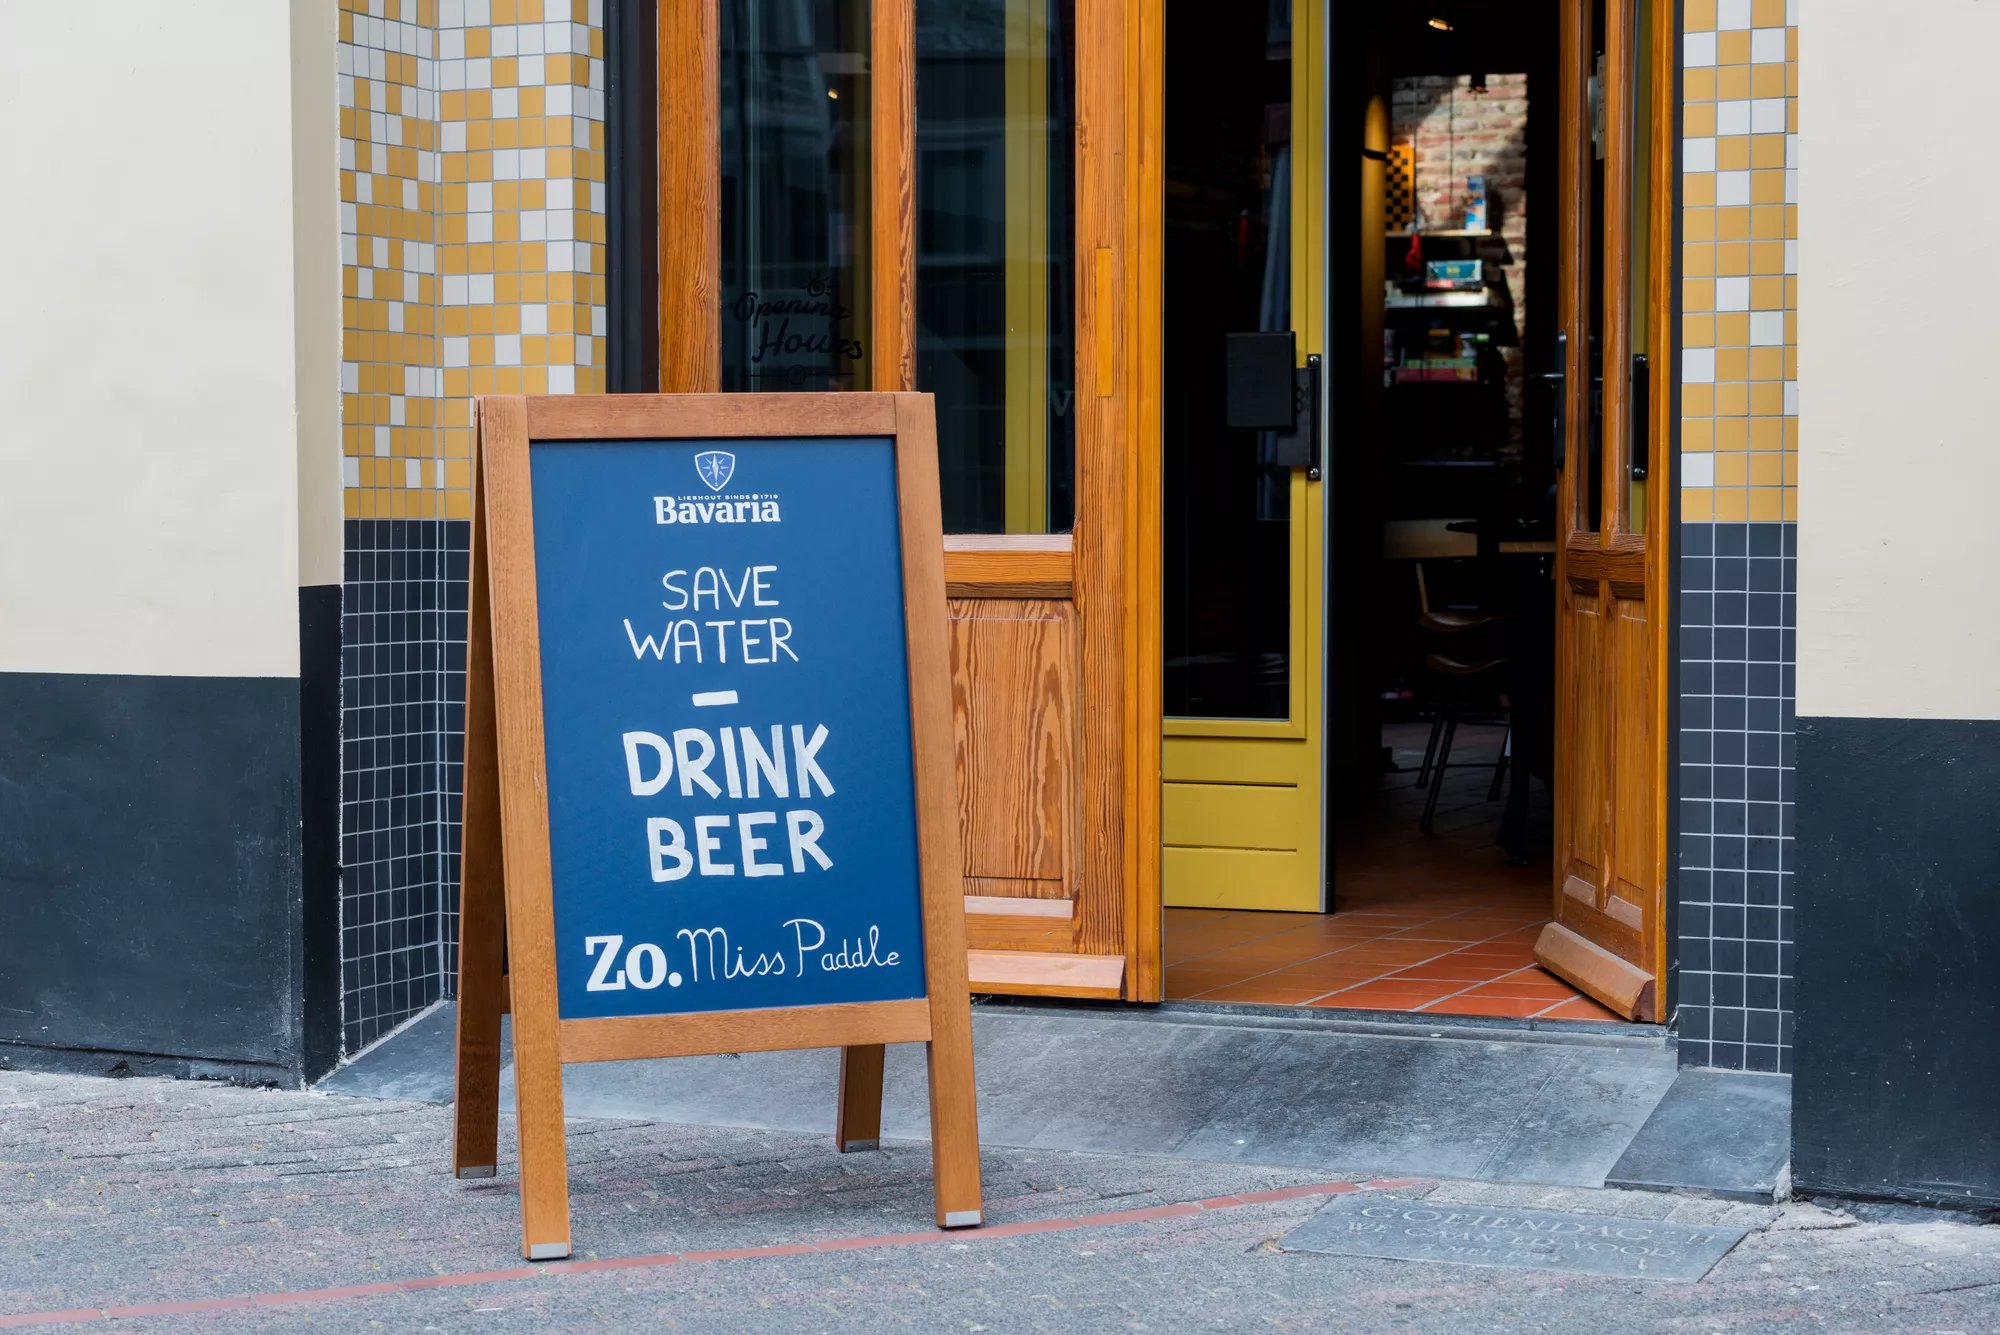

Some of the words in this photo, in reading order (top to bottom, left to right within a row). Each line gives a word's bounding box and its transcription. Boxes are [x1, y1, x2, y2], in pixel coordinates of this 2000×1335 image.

[734, 292, 850, 328] Opening
[752, 318, 863, 363] Hours
[653, 496, 782, 525] Bavaria
[662, 565, 780, 611] SAVE
[623, 617, 799, 664] WATER
[622, 723, 836, 799] DRINK
[646, 809, 834, 883] BEER
[585, 934, 682, 992] Zo.
[677, 926, 786, 982] Miss
[782, 918, 900, 977] Paddle
